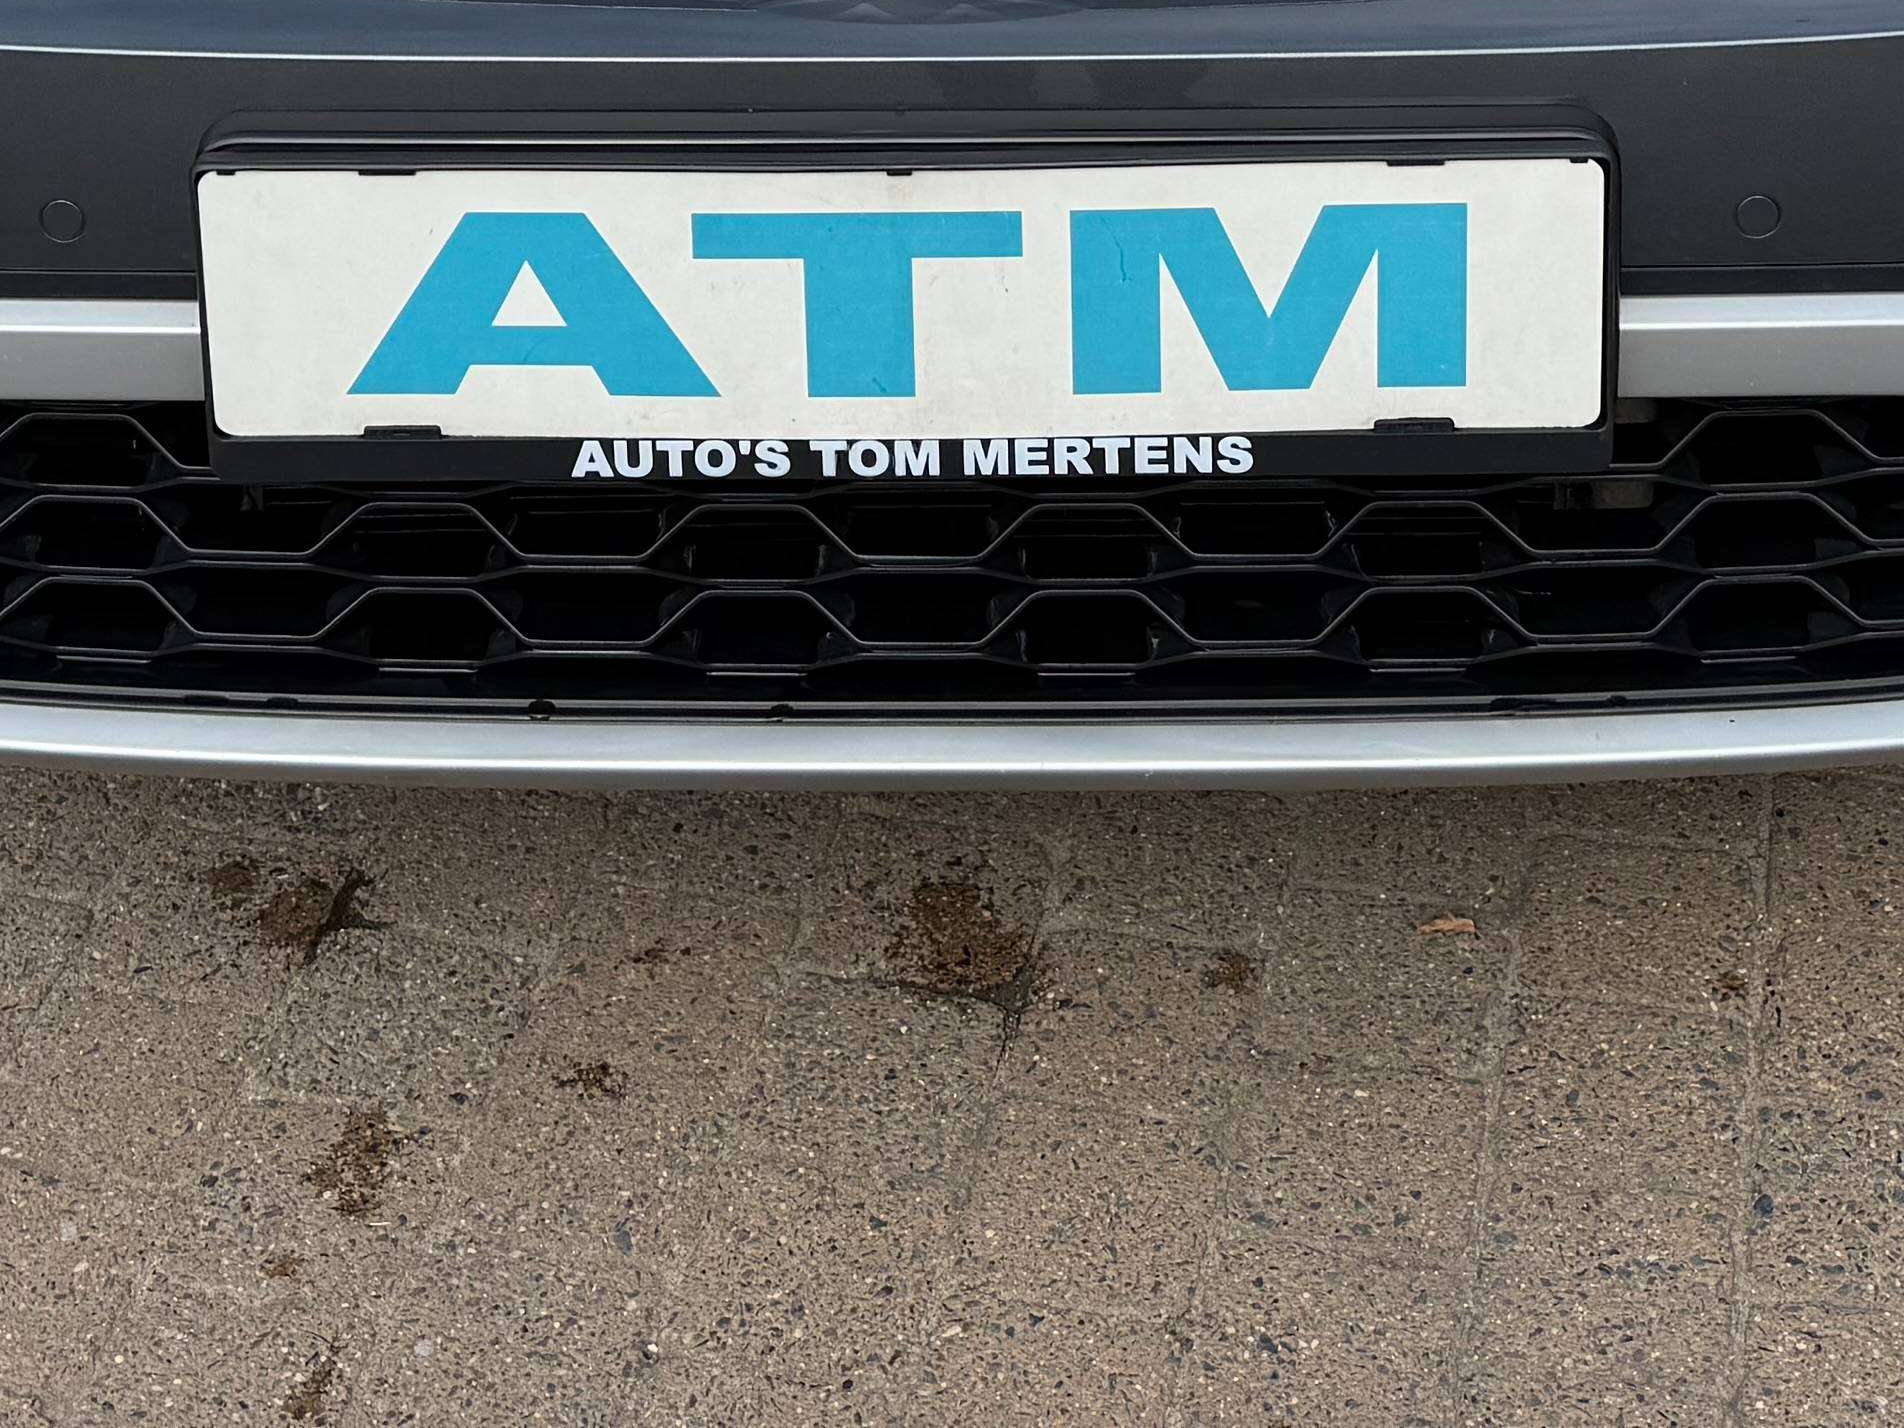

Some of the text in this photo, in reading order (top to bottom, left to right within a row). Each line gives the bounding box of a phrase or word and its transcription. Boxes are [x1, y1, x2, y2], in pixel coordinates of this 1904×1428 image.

[346, 202, 1468, 399] ATM
[570, 435, 1255, 479] AUTO'S TOM MERTENS
